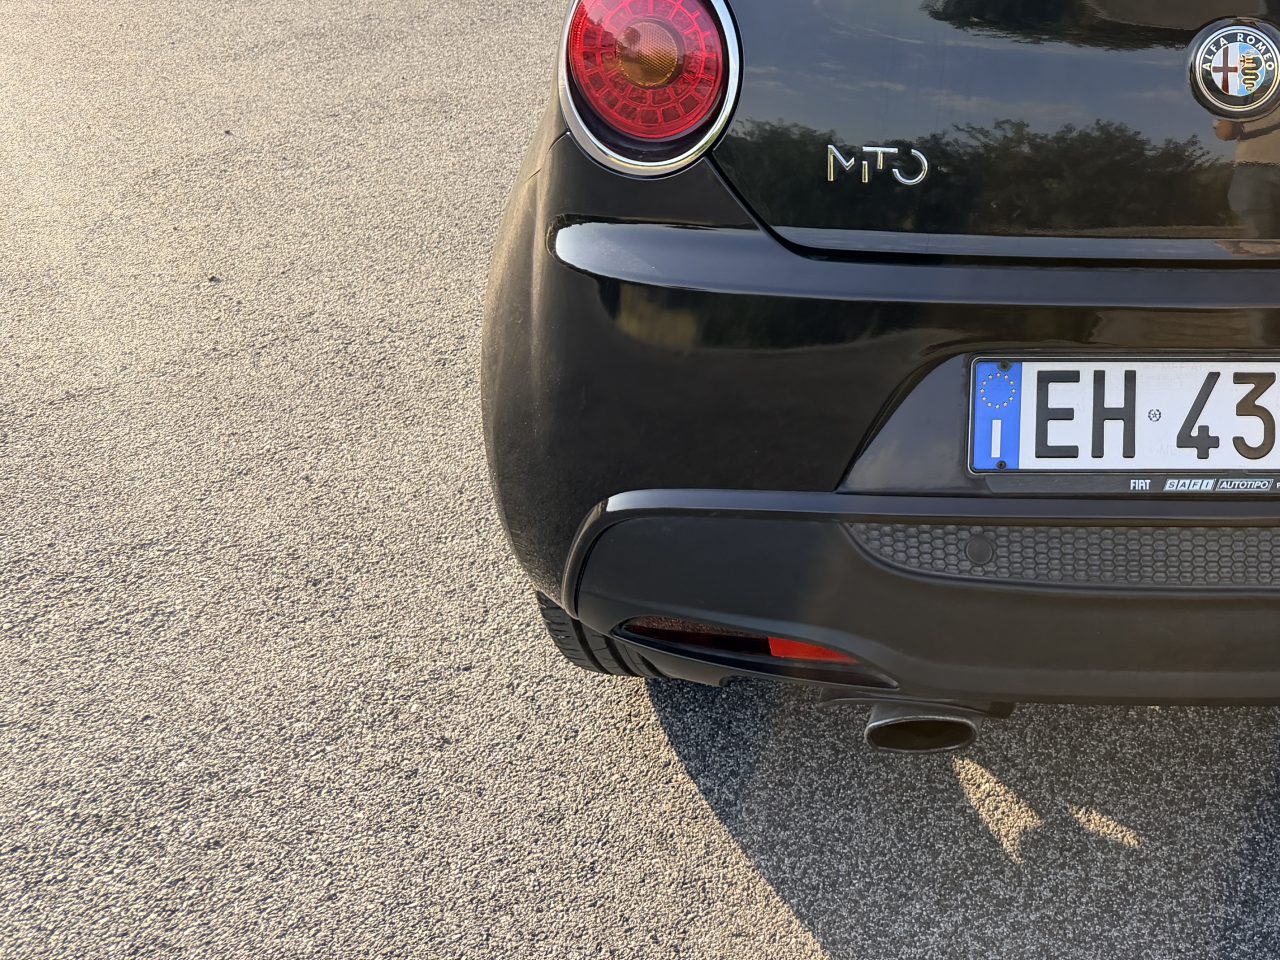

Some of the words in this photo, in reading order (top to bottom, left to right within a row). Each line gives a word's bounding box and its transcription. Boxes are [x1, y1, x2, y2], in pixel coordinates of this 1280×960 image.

[1202, 37, 1229, 71] ALFA
[1236, 33, 1275, 71] ROMEO
[1035, 369, 1137, 459] EH
[1130, 479, 1151, 491] FIAT
[1165, 479, 1213, 491] SAFI
[1218, 480, 1270, 490] AUTOTIPO
